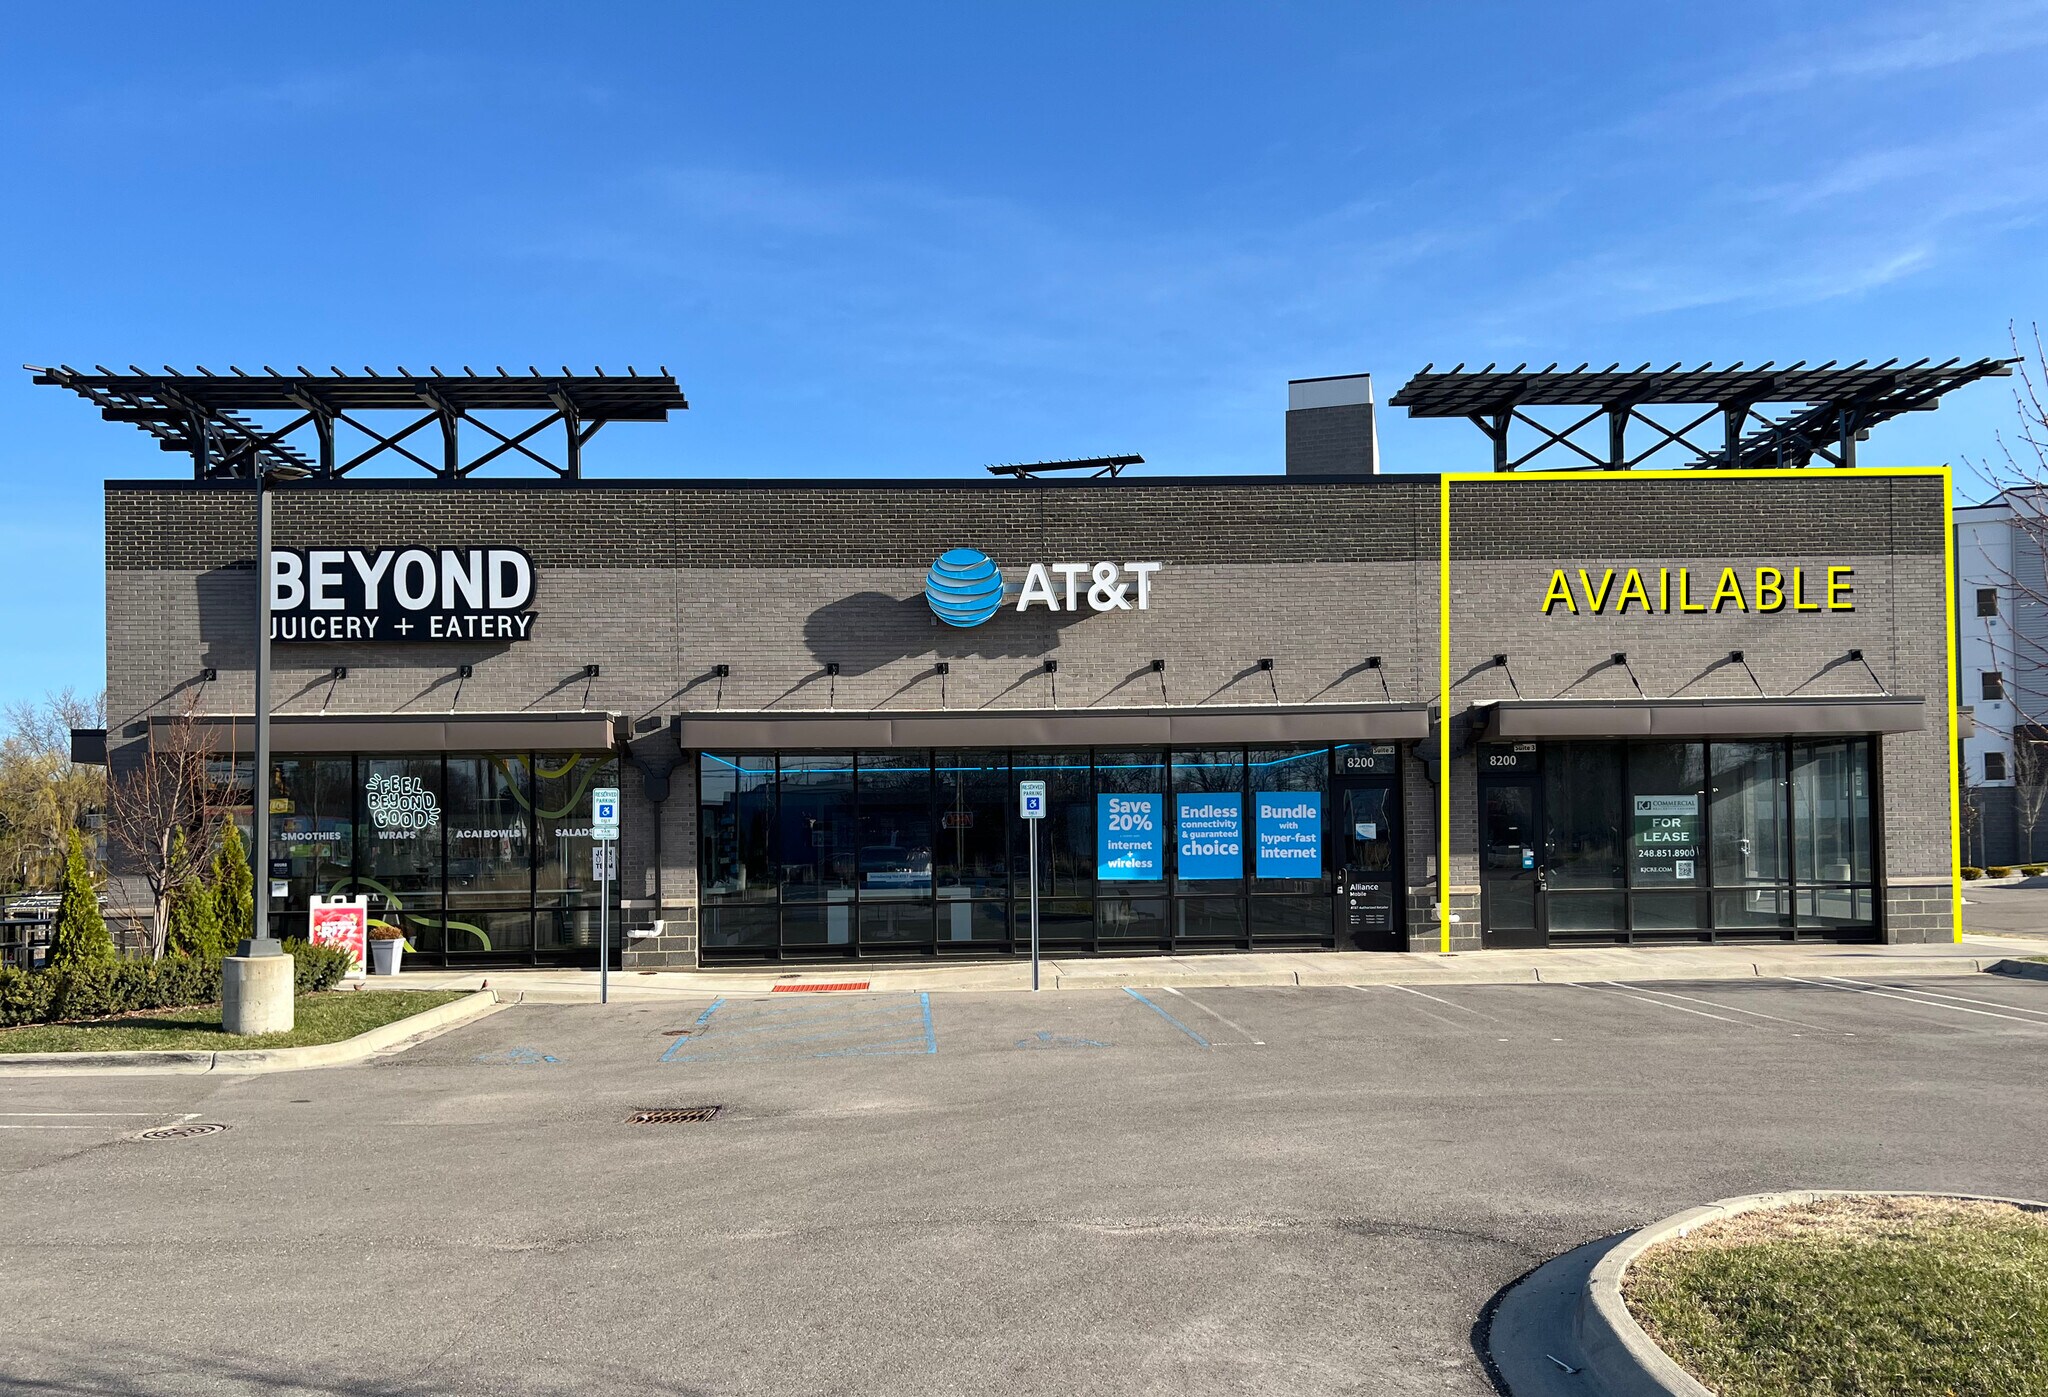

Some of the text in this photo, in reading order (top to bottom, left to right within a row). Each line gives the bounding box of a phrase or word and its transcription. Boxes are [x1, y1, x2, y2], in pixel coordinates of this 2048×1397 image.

[270, 549, 531, 610] BEYOND
[1016, 561, 1162, 612] AT&T
[270, 616, 379, 639] JUICERY
[430, 615, 531, 638] EATERY
[1347, 757, 1375, 768] 8200
[1490, 755, 1517, 766] 8200
[380, 775, 422, 795] FEEL
[367, 791, 435, 811] BEYOND
[1109, 798, 1151, 813] Save
[1181, 806, 1238, 818] Endless
[1261, 804, 1317, 819] Bundle
[374, 809, 428, 829] GOOD
[1109, 815, 1153, 831] 20%
[1181, 819, 1237, 830] connectivity
[1652, 818, 1681, 828] FOR
[281, 831, 341, 841] SMOOTHIES
[378, 831, 416, 840] WRAPS
[456, 829, 521, 838] ACAI BOWLS
[1181, 830, 1238, 840] & guaranteed
[1261, 833, 1316, 844] hyper-fast
[1643, 832, 1690, 842] LEASE
[1107, 840, 1153, 850] internet
[1181, 840, 1239, 855] choice
[1261, 847, 1317, 859] internet
[1638, 849, 1695, 858] 248.851.8900
[1107, 858, 1153, 868] wireless
